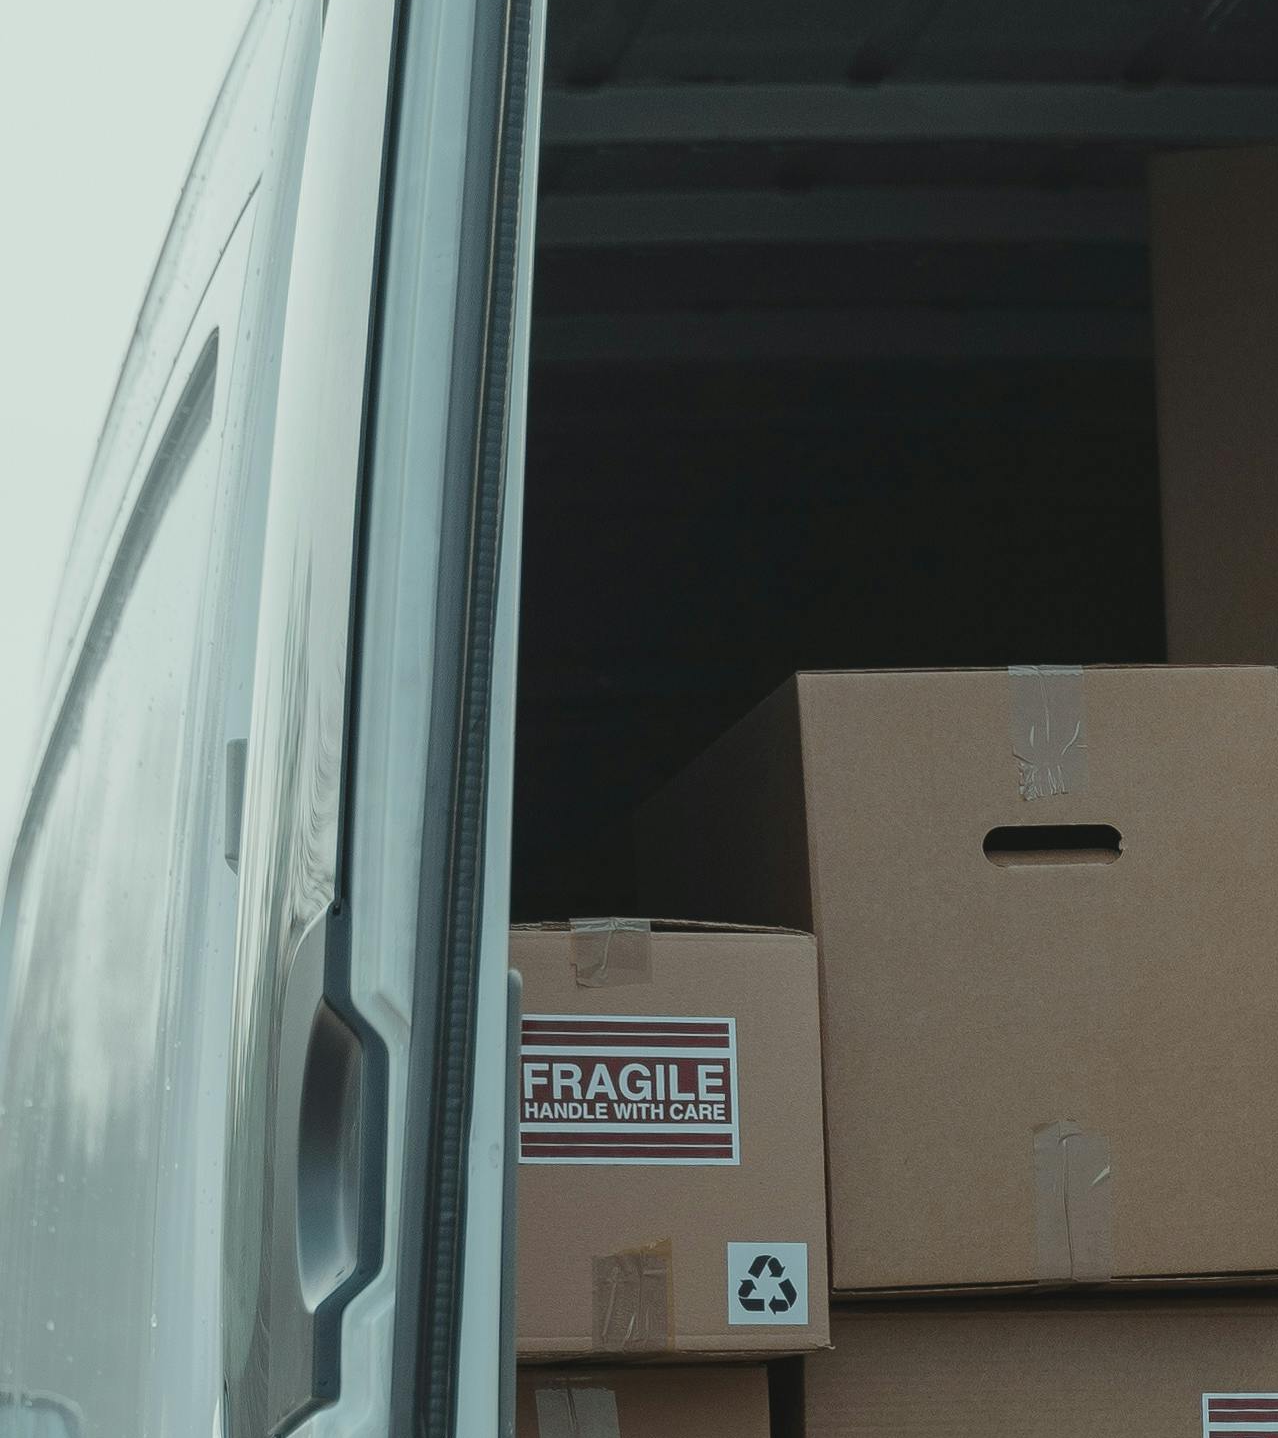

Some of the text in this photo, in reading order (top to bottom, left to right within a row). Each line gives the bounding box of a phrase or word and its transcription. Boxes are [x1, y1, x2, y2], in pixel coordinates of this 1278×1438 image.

[523, 1063, 726, 1101] FRAGILE
[525, 1102, 726, 1121] HANDLE WITH CARE
